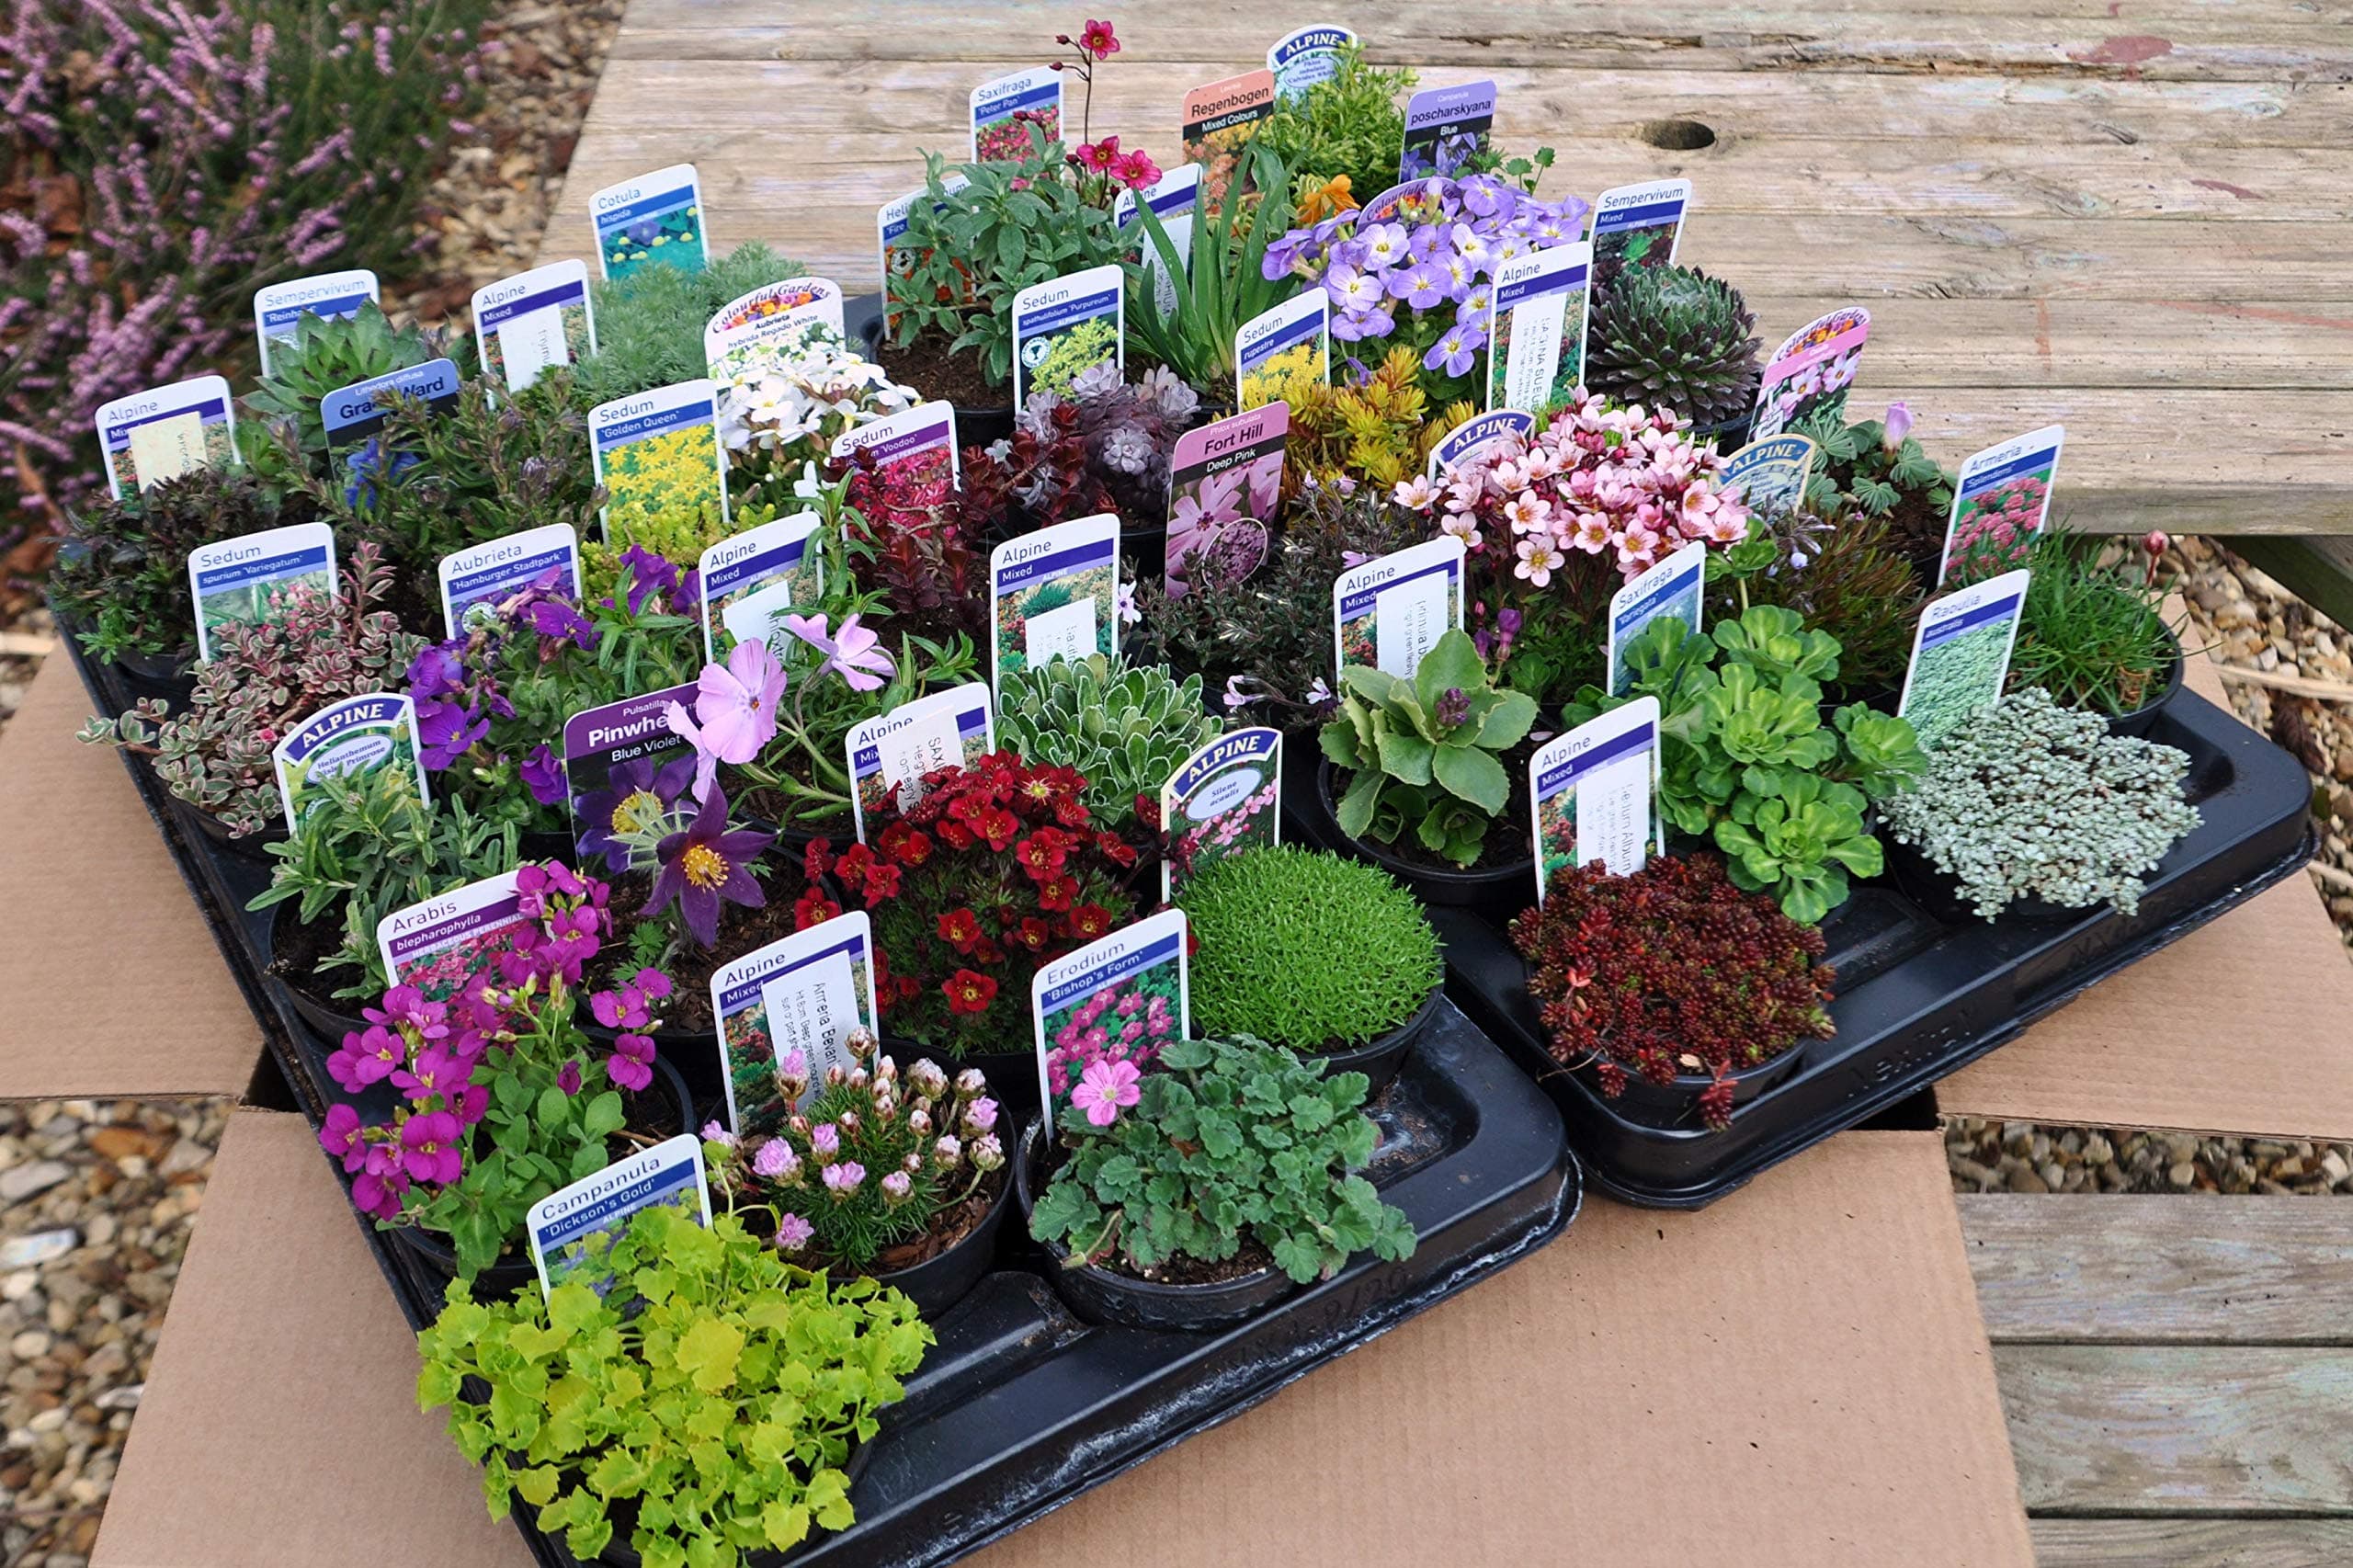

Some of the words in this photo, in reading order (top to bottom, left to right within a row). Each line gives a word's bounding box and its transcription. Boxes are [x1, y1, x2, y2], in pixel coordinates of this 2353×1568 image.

[1286, 32, 1342, 56] ALPINE
[978, 78, 1032, 102] Saxifraga
[1191, 87, 1269, 118] Regenbogen
[1411, 100, 1491, 126] poscharskyana
[1201, 119, 1227, 133] Mixed
[1227, 109, 1258, 126] Colours
[1439, 125, 1459, 137] Blue
[597, 188, 642, 210] Cotula
[1122, 187, 1157, 209] Alne
[1367, 183, 1421, 222] Colourful
[1604, 187, 1684, 209] Sempervivum
[1599, 212, 1624, 224] Mixed
[1501, 263, 1541, 284] Alpine
[264, 280, 366, 308] Sempervivum
[482, 284, 527, 308] Alpine
[1022, 289, 1070, 311] Sedum
[1500, 285, 1526, 300] Mixed
[482, 306, 514, 324] Mixed
[711, 289, 776, 335] Colourful
[778, 282, 832, 300] Gardens
[1243, 317, 1283, 344] Sedum
[1243, 338, 1275, 360] rupestre
[108, 401, 159, 423] Alpine
[599, 400, 655, 424] Sedum
[841, 425, 894, 453] Sedum
[1203, 433, 1237, 455] Fort
[1239, 422, 1265, 444] Hill
[1206, 459, 1233, 473] Deep
[1234, 448, 1256, 461] Pink
[1731, 443, 1797, 474] ALPINE
[1969, 445, 2023, 474] Armeria
[200, 546, 262, 568] Sedum
[450, 545, 523, 574] Aubrieta
[710, 542, 757, 569] Alpine
[1002, 540, 1052, 565] Alpine
[202, 569, 242, 585] spurium
[710, 567, 741, 587] Mixed
[749, 569, 775, 584] ALPINE
[1001, 563, 1034, 583] Mixed
[1041, 568, 1070, 582] ALPINE
[1345, 566, 1396, 594] Alpine
[1345, 590, 1378, 610] Mixed
[1619, 566, 1674, 610] Saxifraga
[622, 699, 665, 717] Pulsatilla
[301, 702, 385, 749] ALPINE
[588, 715, 669, 747] Pinwhe
[317, 740, 381, 770] Helianthemum
[346, 746, 386, 767] Primrose
[611, 747, 642, 763] Blue
[643, 733, 682, 754] Violet
[1189, 734, 1260, 783] ALPINE
[1540, 736, 1592, 769] Alpine
[1540, 764, 1574, 788] Mixed
[1209, 788, 1240, 807] acaulis
[1211, 780, 1237, 798] Silene
[392, 902, 458, 934] Arabis
[396, 914, 482, 951] blepharophylla
[413, 930, 472, 960] HERBACEOUS
[472, 913, 526, 937] PERENNIAL
[724, 953, 787, 988] Alpine
[1047, 942, 1125, 985] Erodium
[726, 981, 765, 1004] Mixed
[542, 1158, 661, 1221] Campanula
[602, 1204, 638, 1225] ALPINE
